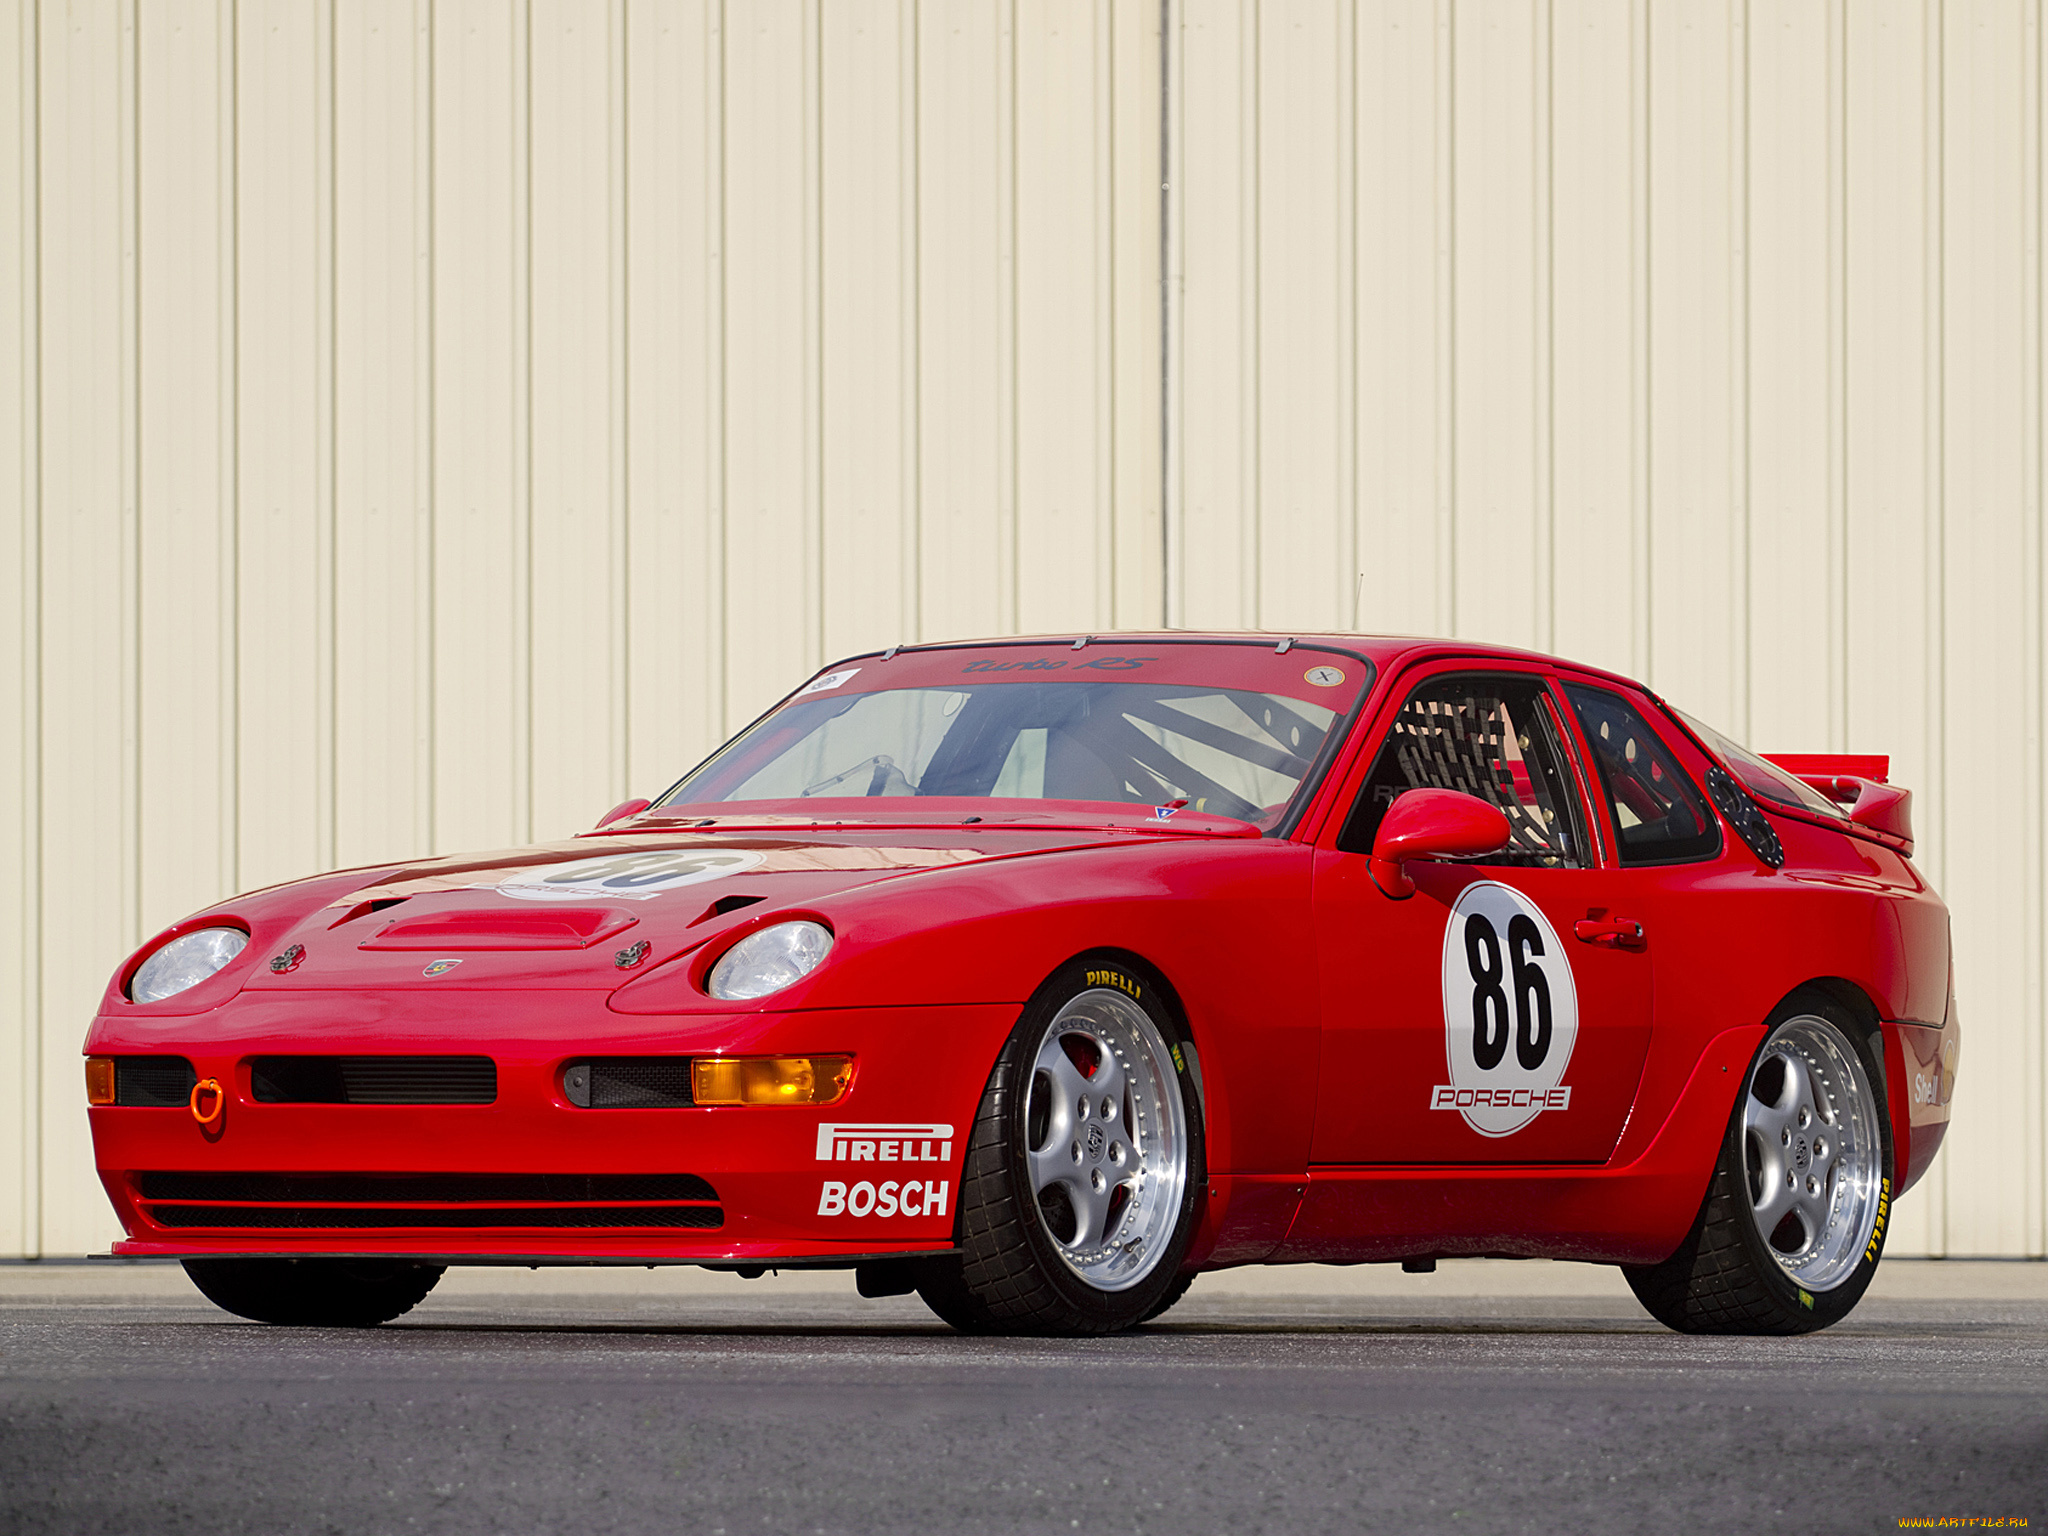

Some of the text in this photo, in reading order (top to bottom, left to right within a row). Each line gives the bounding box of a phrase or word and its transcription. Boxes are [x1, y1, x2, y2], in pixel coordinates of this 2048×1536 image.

[962, 656, 1159, 673] turbo RS
[542, 853, 744, 888] 86
[1086, 970, 1142, 999] PIRELLI
[1464, 913, 1552, 1071] 86
[1436, 1089, 1566, 1107] PORSCHE
[1914, 1073, 1938, 1104] Shell
[815, 1122, 954, 1161] PIRELLI
[817, 1180, 949, 1218] BOSCH
[1865, 1177, 1890, 1263] PIRELLI
